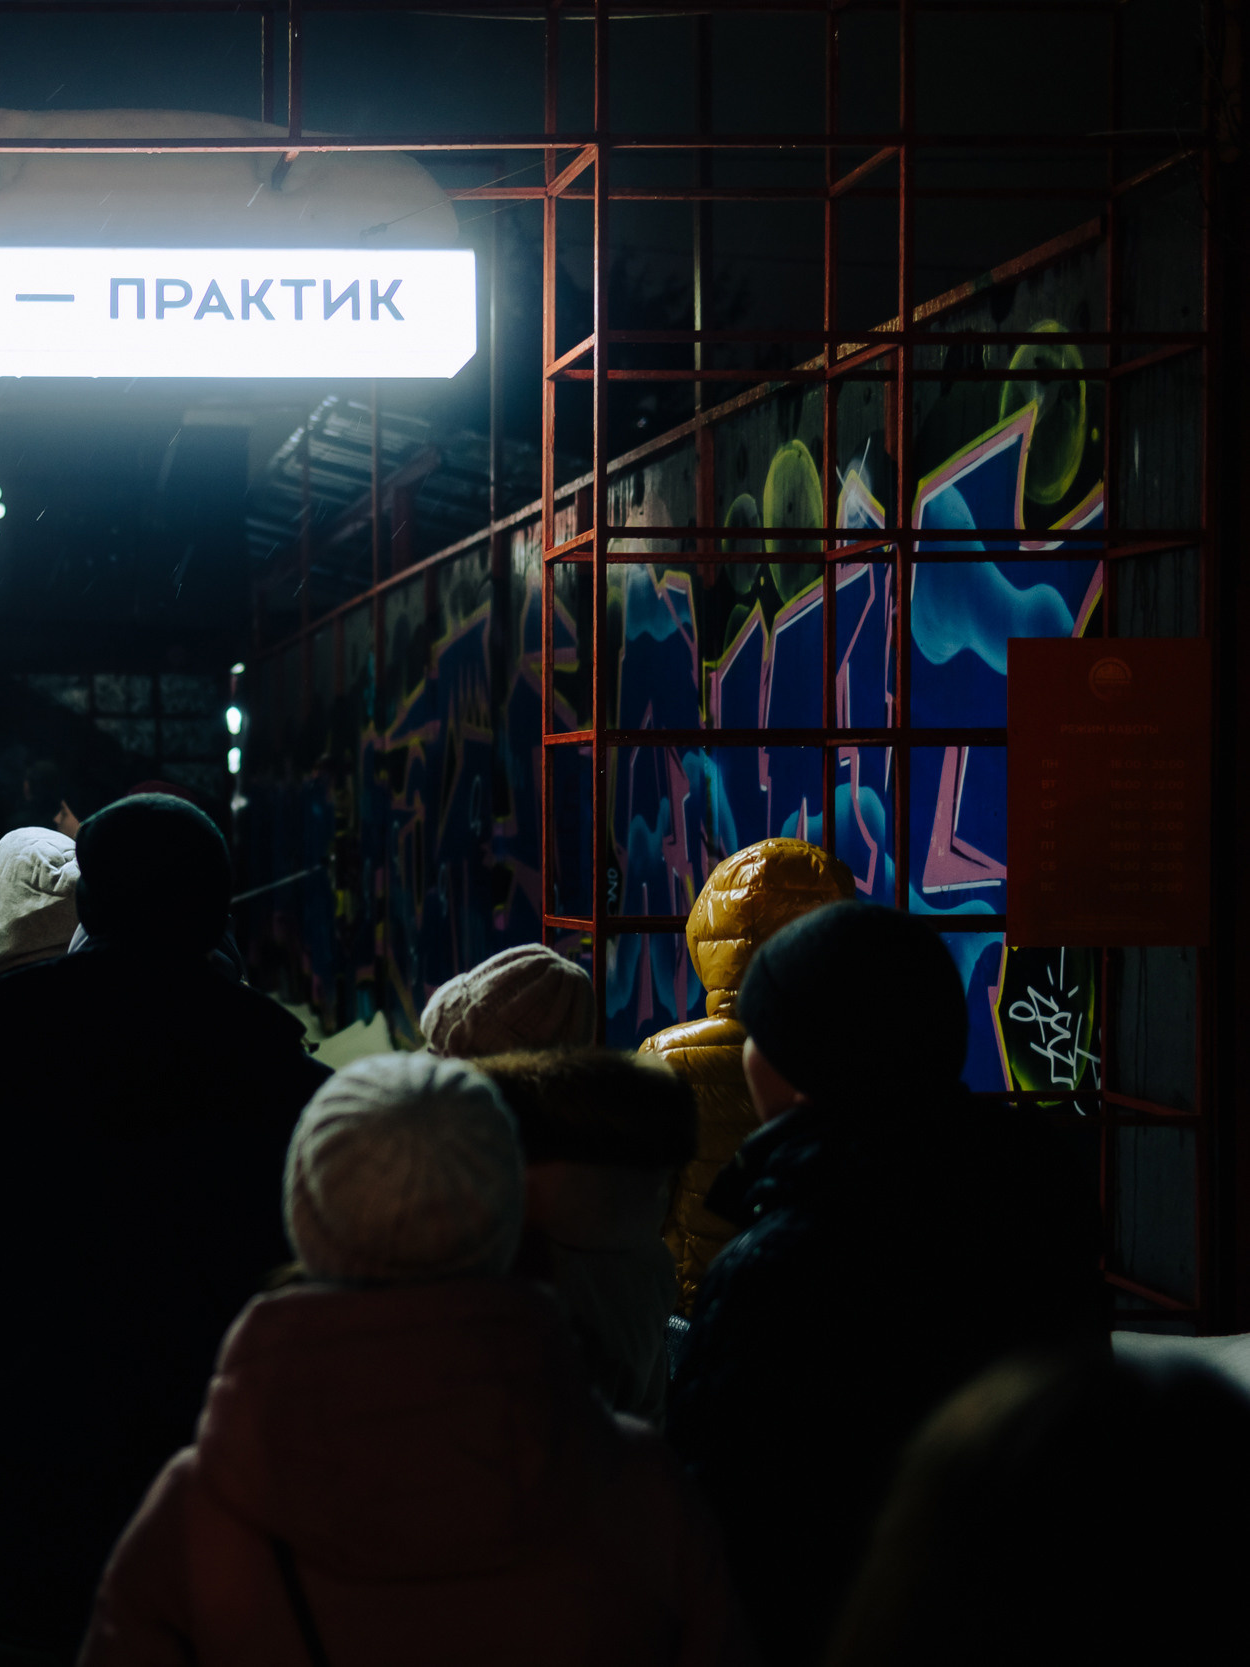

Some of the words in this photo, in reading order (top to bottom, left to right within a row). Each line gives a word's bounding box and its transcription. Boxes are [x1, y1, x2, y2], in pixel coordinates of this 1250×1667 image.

[110, 277, 405, 321] ПРАКТИК
[1060, 723, 1105, 734] РЕЖИМ
[1108, 723, 1159, 734] РАБОТЫ
[1041, 759, 1059, 769] ПН
[1041, 779, 1057, 790] ВТ
[1040, 799, 1058, 810] СР
[1040, 820, 1056, 830] ЧТ
[1040, 840, 1056, 851] ПТ
[1040, 861, 1057, 871] СБ
[1040, 881, 1056, 892] ВС
